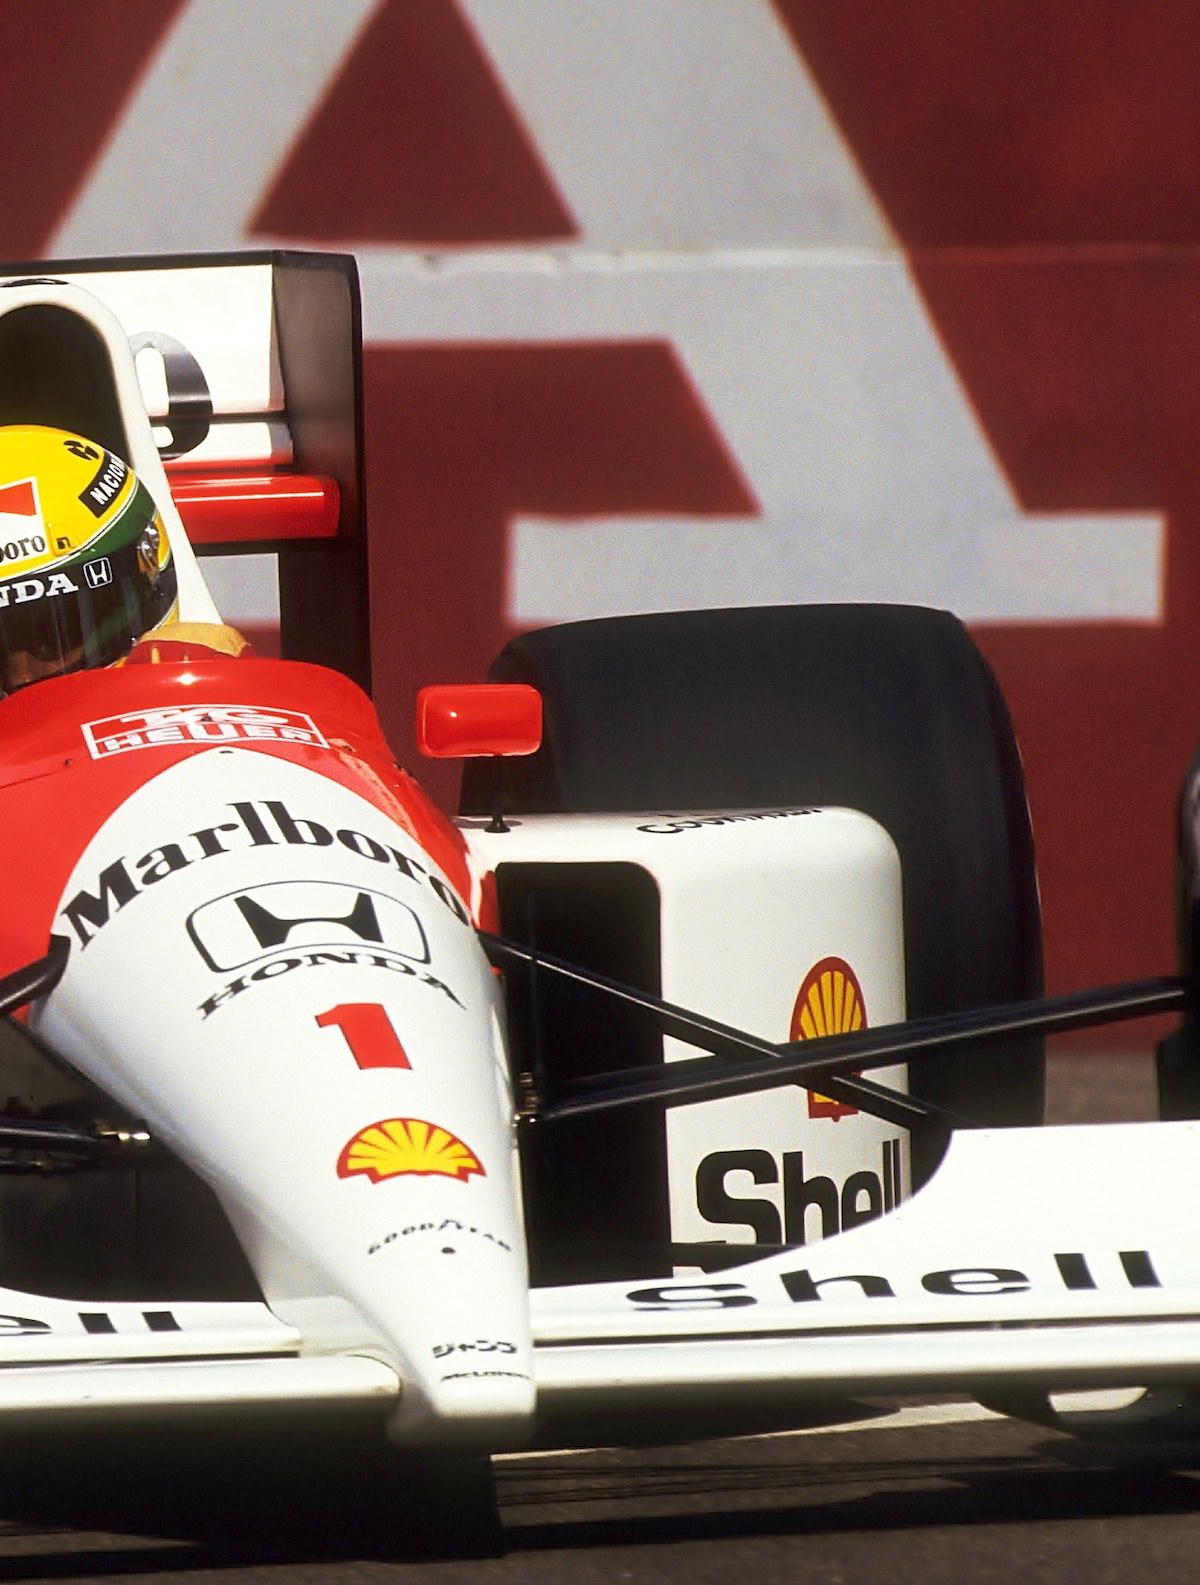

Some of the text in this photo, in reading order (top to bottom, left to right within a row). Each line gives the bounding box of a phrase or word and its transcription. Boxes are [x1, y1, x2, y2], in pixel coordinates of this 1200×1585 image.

[103, 722, 313, 751] HEUER
[61, 801, 472, 951] Marlboro
[197, 951, 468, 1020] HONDA
[315, 1003, 412, 1070] 1
[696, 1138, 901, 1245] Shell
[627, 1250, 1162, 1311] Shell
